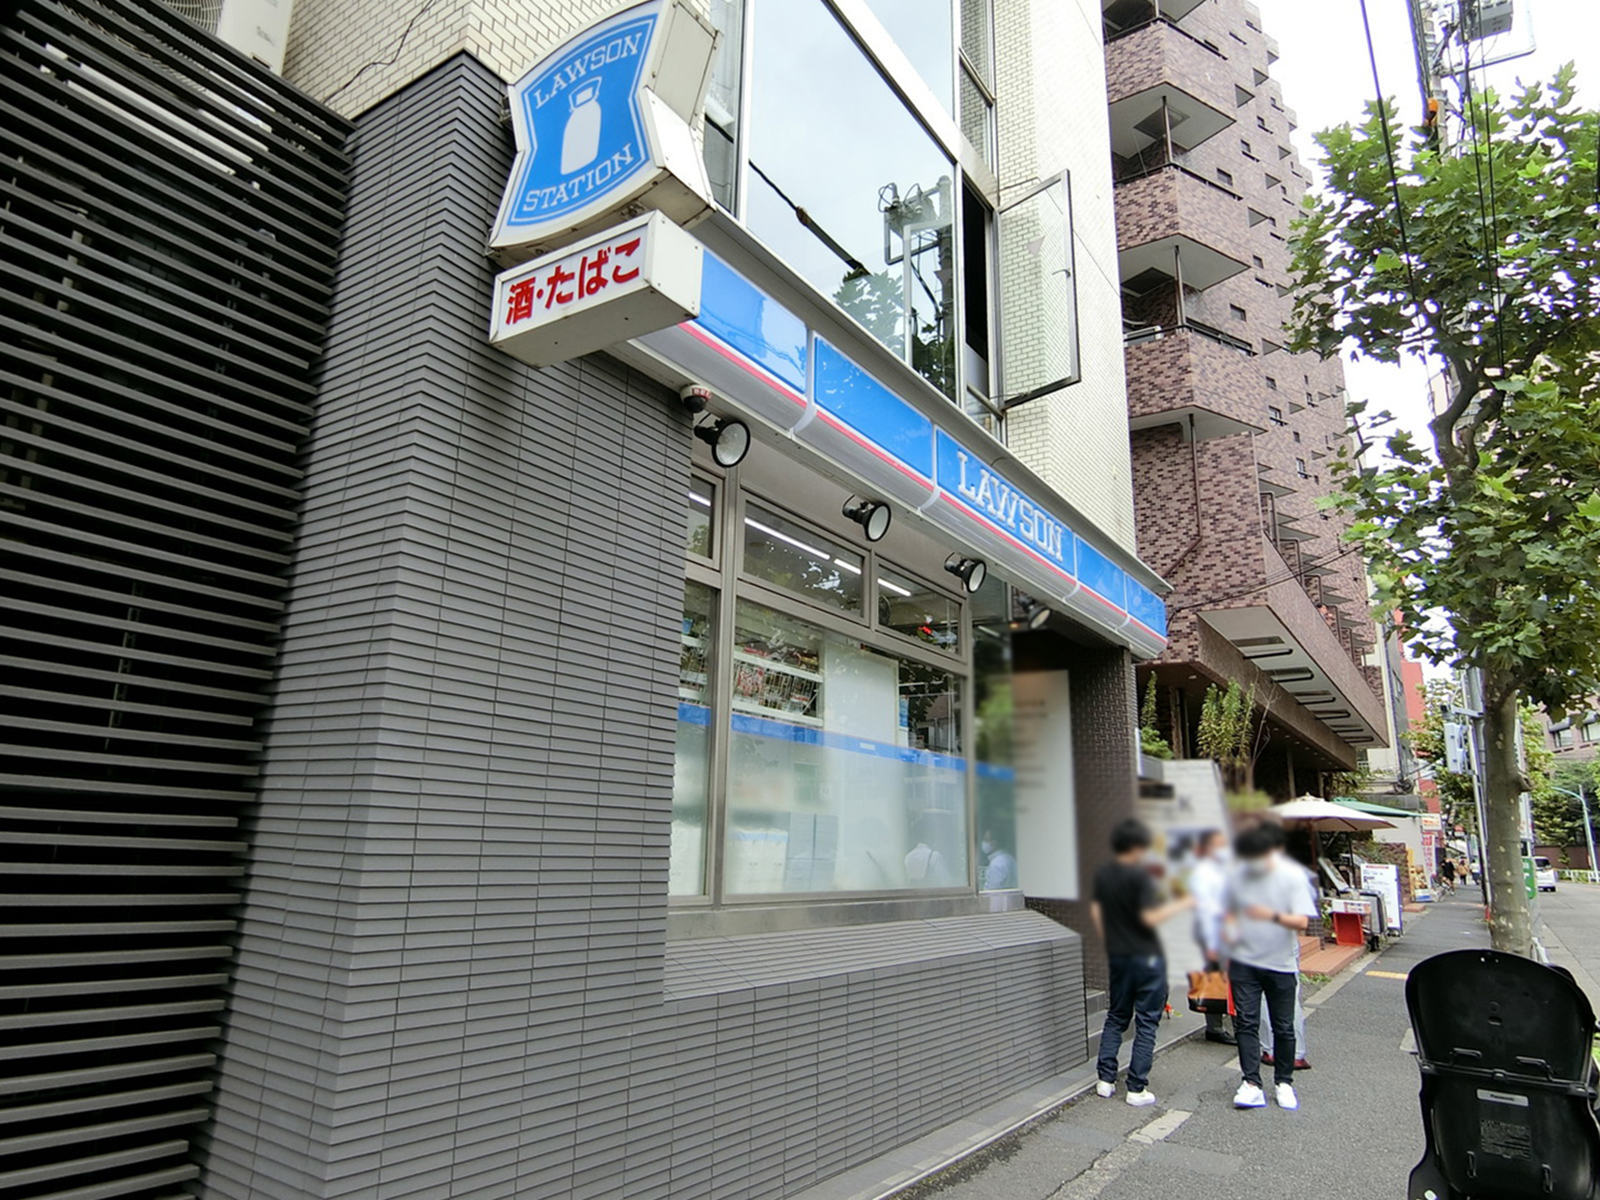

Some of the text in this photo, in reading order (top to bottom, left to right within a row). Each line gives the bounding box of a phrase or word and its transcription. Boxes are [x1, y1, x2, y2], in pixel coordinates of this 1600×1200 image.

[533, 32, 642, 110] LAWSON
[522, 143, 634, 212] STATION
[505, 237, 641, 325] 酒・たばこ
[957, 451, 1064, 562] LAWSON
